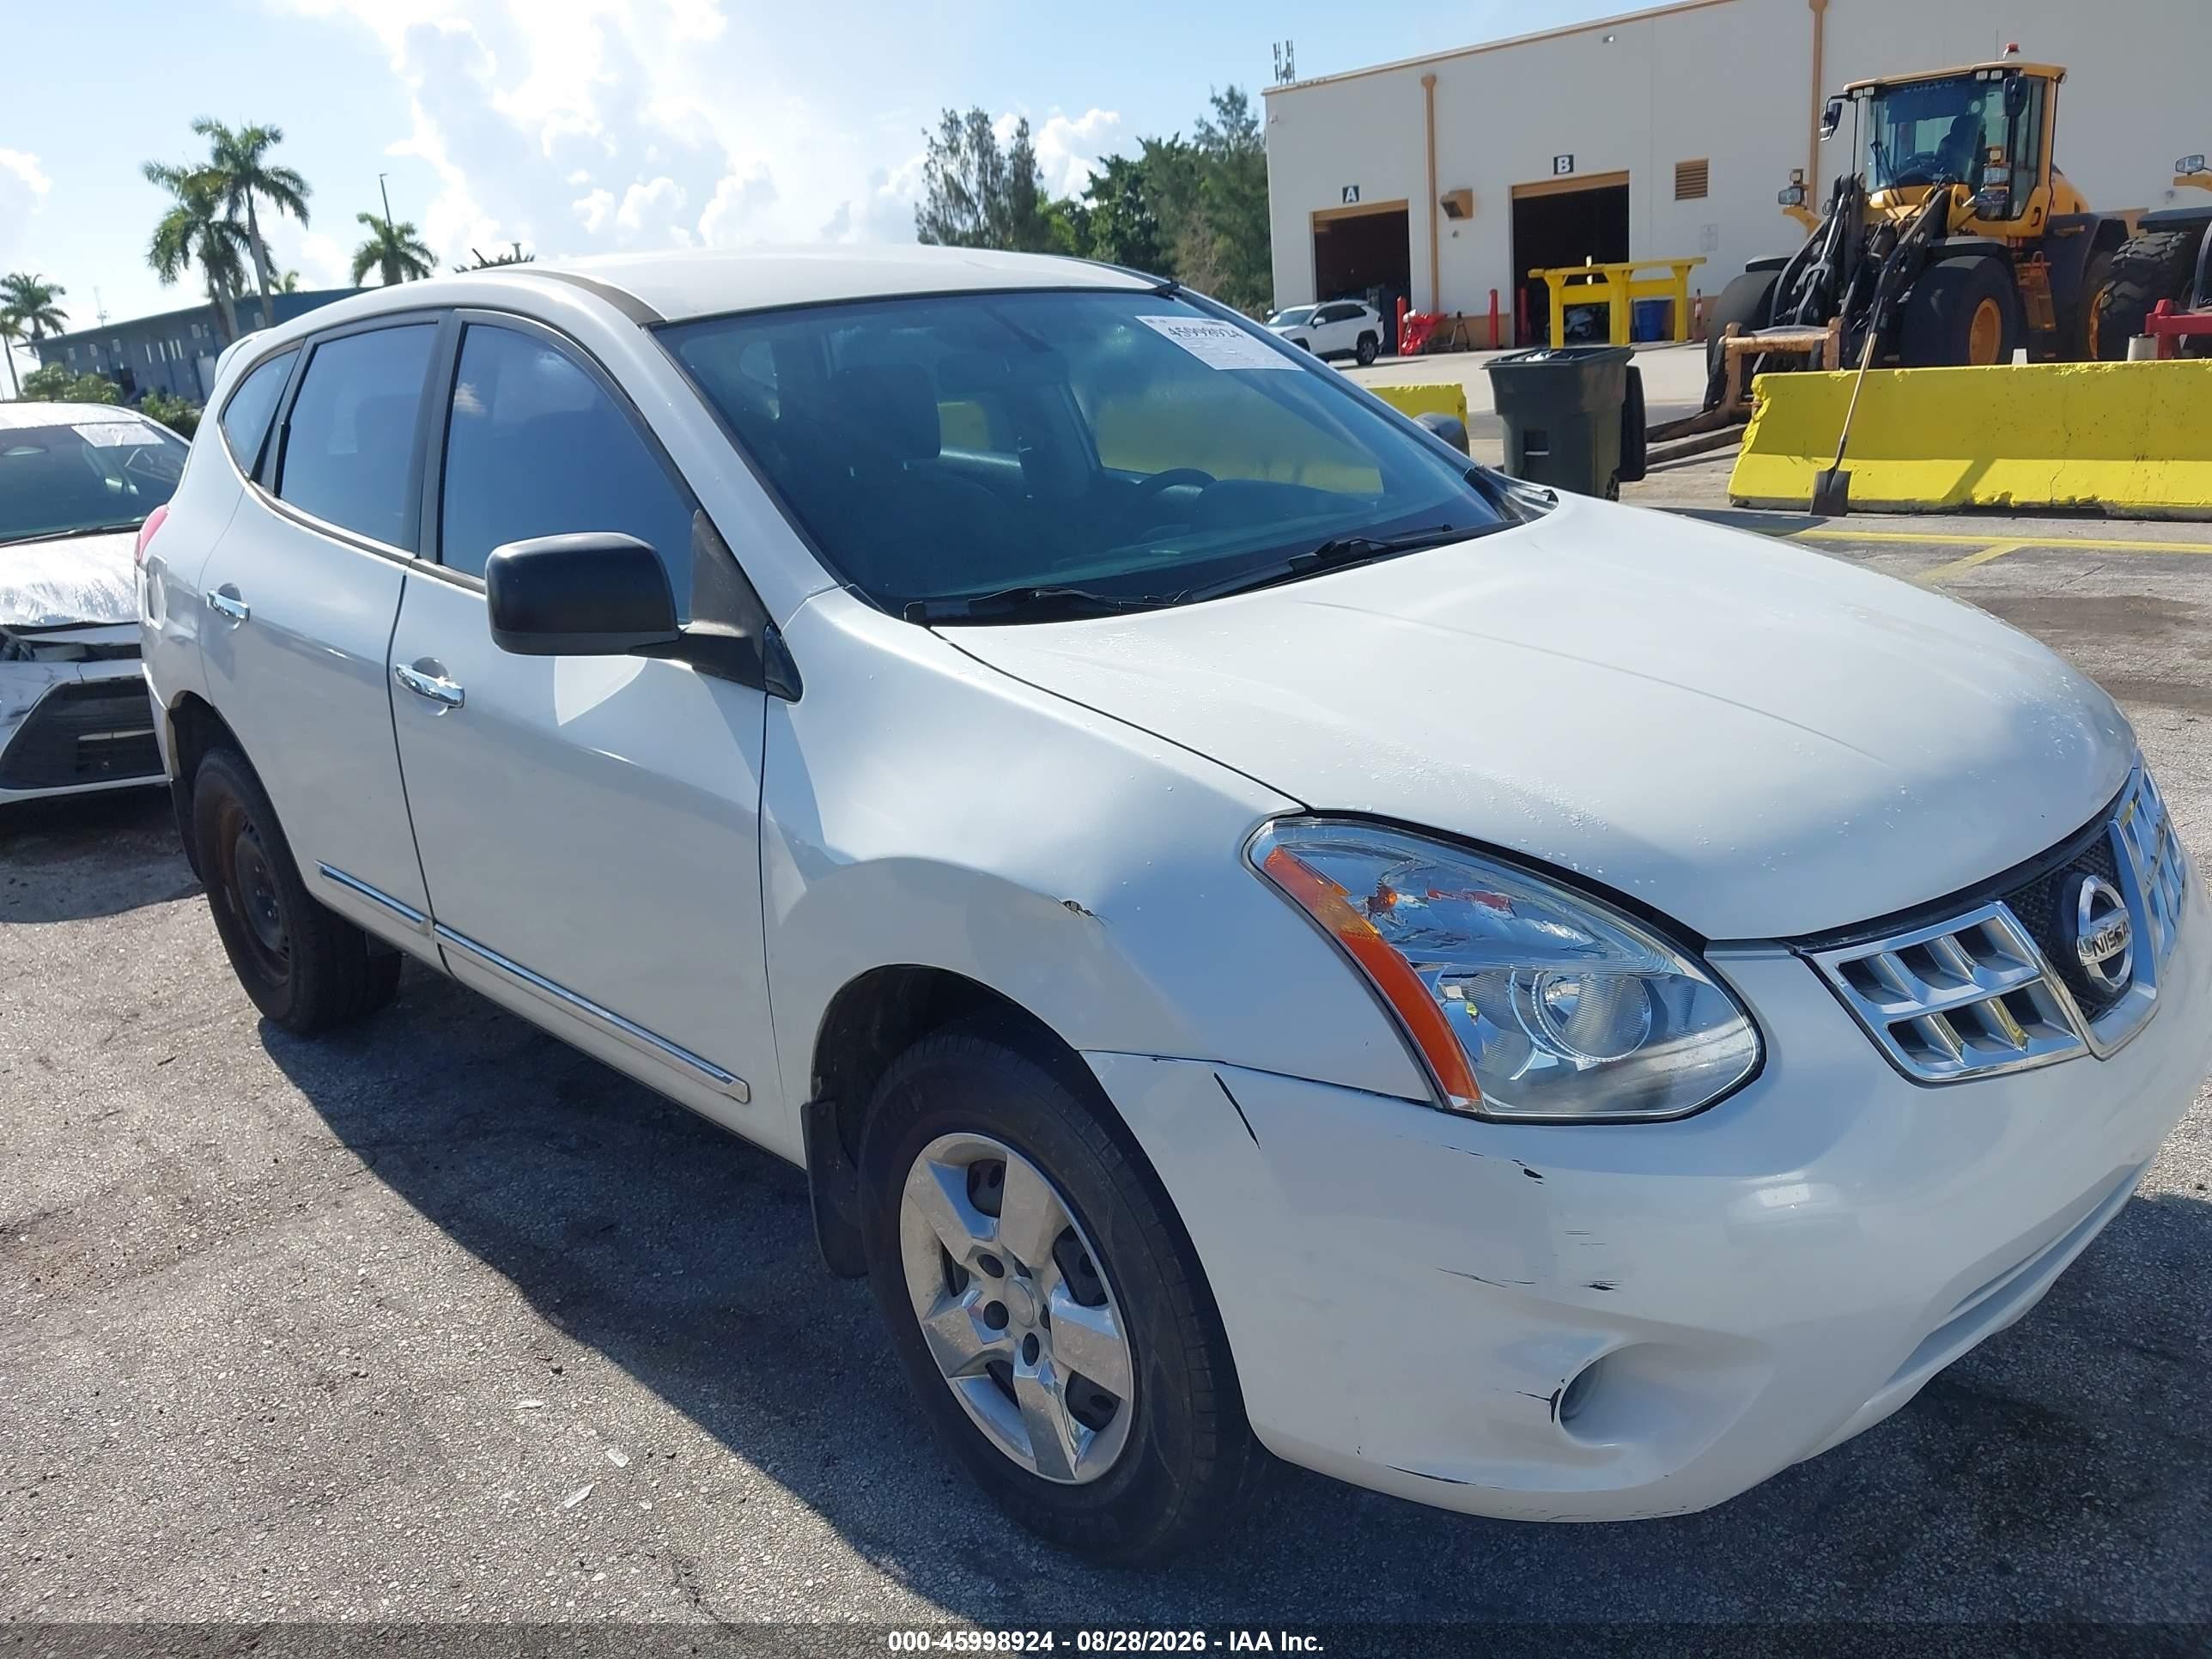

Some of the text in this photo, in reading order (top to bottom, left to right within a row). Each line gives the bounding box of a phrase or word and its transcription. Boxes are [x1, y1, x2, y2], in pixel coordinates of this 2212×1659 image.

[1557, 156, 1571, 173] B
[1346, 186, 1358, 203] A
[2092, 920, 2130, 957] NISSA
